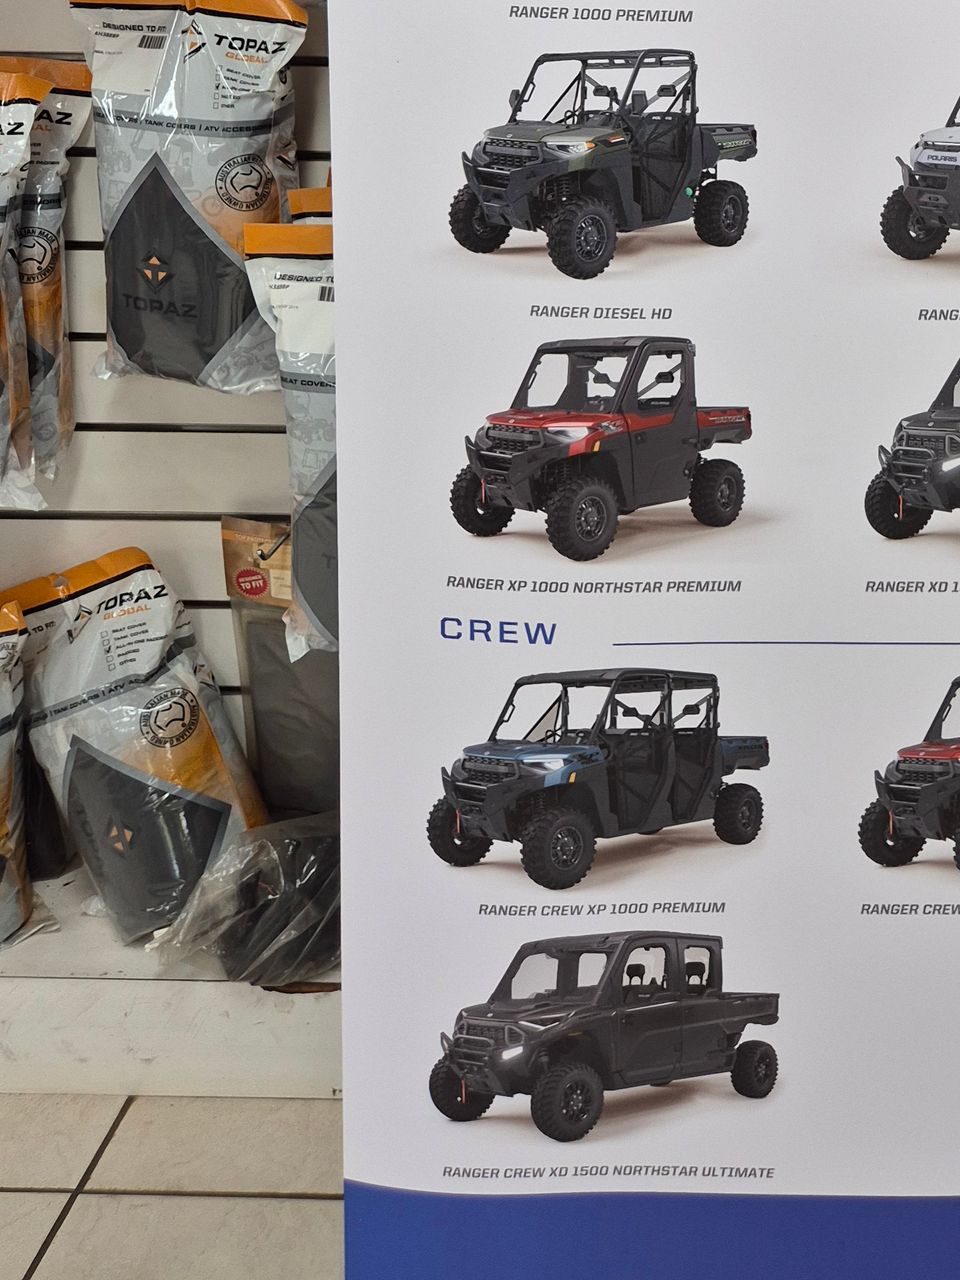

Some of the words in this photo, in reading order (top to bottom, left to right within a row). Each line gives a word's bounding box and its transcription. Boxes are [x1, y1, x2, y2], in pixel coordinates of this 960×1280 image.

[509, 6, 568, 20] RANGER
[572, 8, 612, 22] 1000
[615, 8, 693, 23] PREMIUM
[102, 22, 144, 32] DESIGNED
[214, 33, 288, 55] TOPAZ
[122, 292, 199, 319] TOPAZ
[530, 305, 590, 319] RANGER
[593, 306, 647, 320] DIESEL
[650, 308, 673, 320] HD
[446, 576, 504, 592] RANGER
[508, 580, 528, 592] XP
[530, 580, 570, 593] 1000
[572, 580, 663, 594] NORTHSTAR
[666, 580, 742, 593] PREMIUM
[865, 580, 925, 593] RANGER
[928, 580, 948, 593] XD
[96, 584, 169, 614] TOPAZ
[440, 616, 557, 645] CREW
[478, 903, 537, 916] RANGER
[540, 903, 583, 916] CREW
[586, 903, 608, 916] XP
[610, 902, 648, 916] 1000
[651, 901, 726, 914] PREMIUM
[860, 903, 919, 916] RANGER
[442, 1166, 500, 1179] RANGER
[503, 1166, 546, 1179] CREW
[548, 1166, 569, 1178] XD
[572, 1165, 610, 1177] 1500
[612, 1164, 698, 1177] NORTHSTAR
[701, 1165, 775, 1178] ULTIMATE
